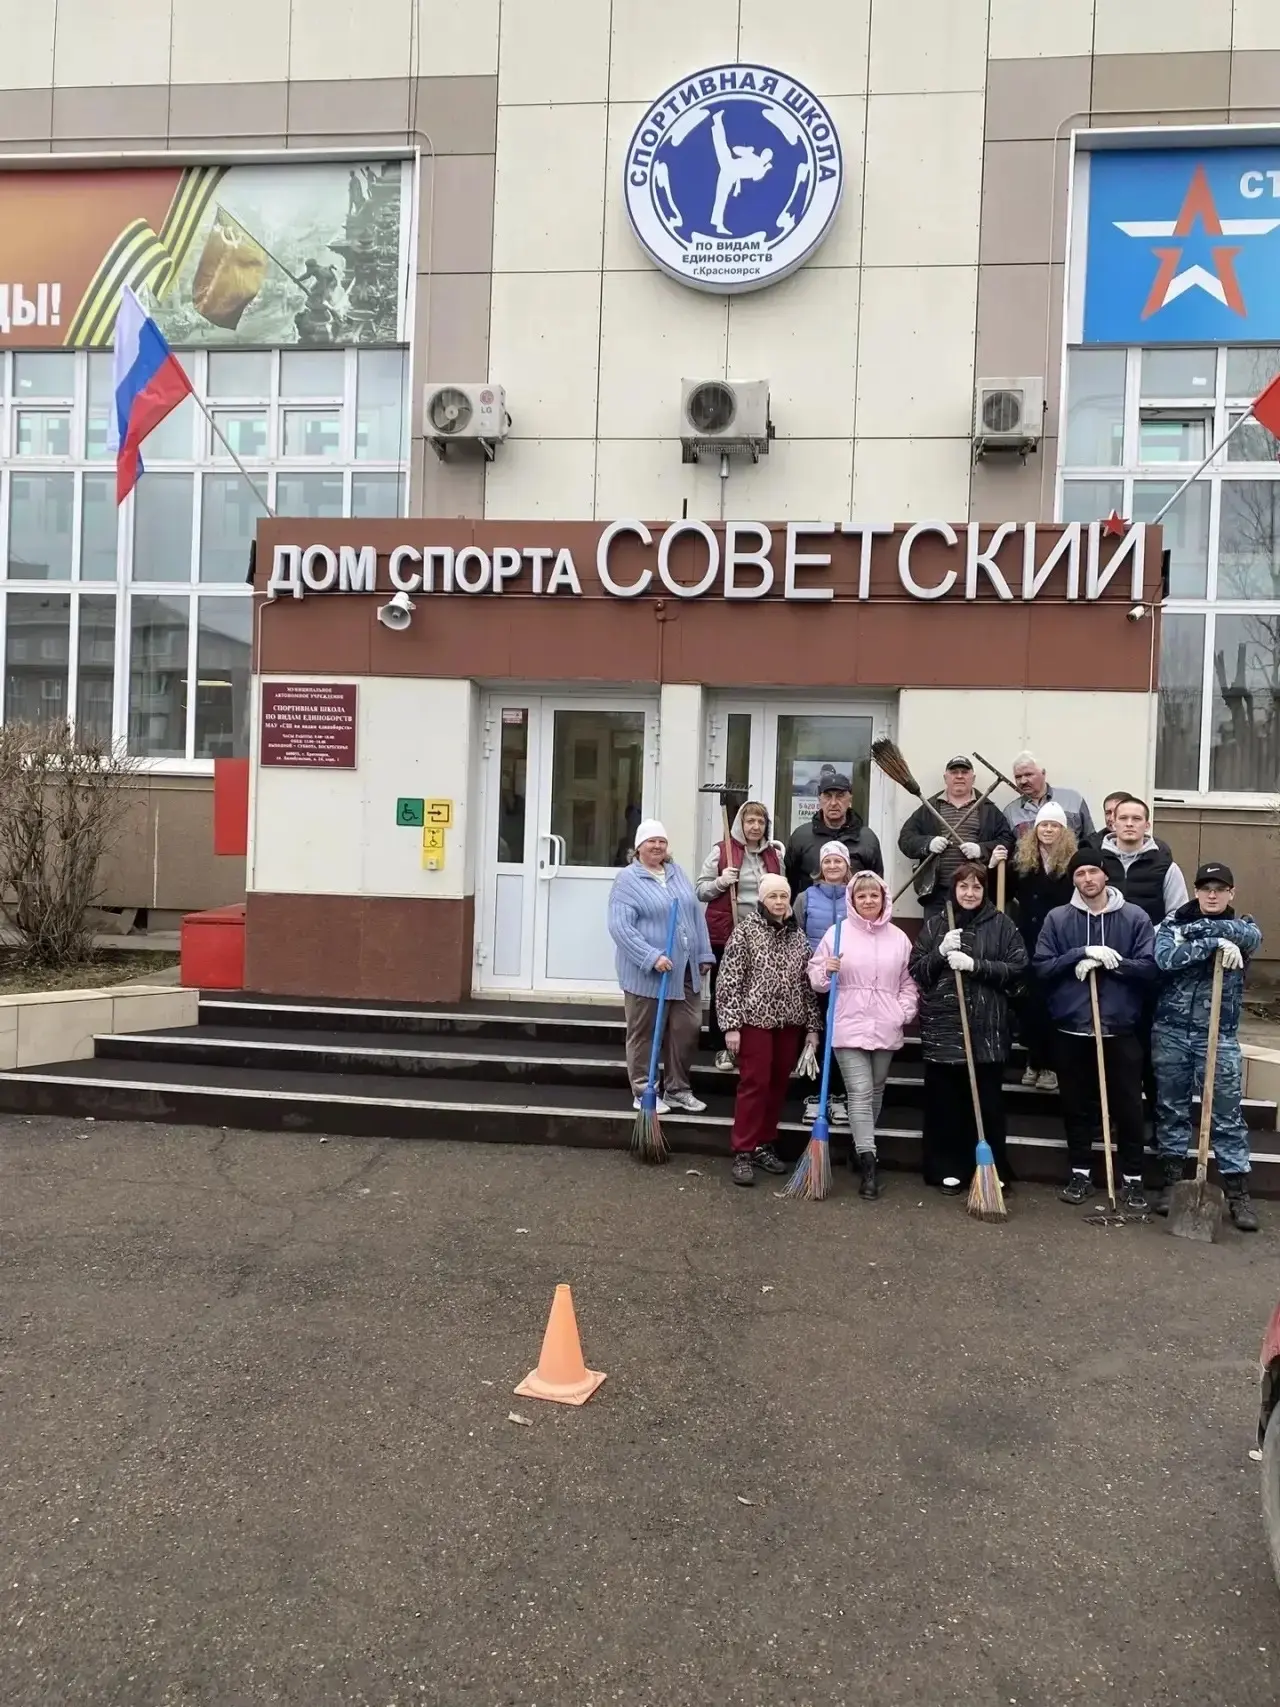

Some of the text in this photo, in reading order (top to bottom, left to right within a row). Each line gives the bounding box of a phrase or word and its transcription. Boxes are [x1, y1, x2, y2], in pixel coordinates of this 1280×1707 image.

[630, 71, 837, 187] СПОРТИВНАЯ ШКОЛА
[695, 241, 760, 252] ПО ВИДАМ
[682, 253, 773, 264] ЕДИНОБОРСТВ
[693, 266, 761, 277] г.Красноярск
[267, 517, 1147, 601] ДОМ СПОРТА СОВЕТСКИЙ
[277, 713, 301, 721] ВИДАМ
[303, 714, 353, 722] ЕДИНОБОРСТВ
